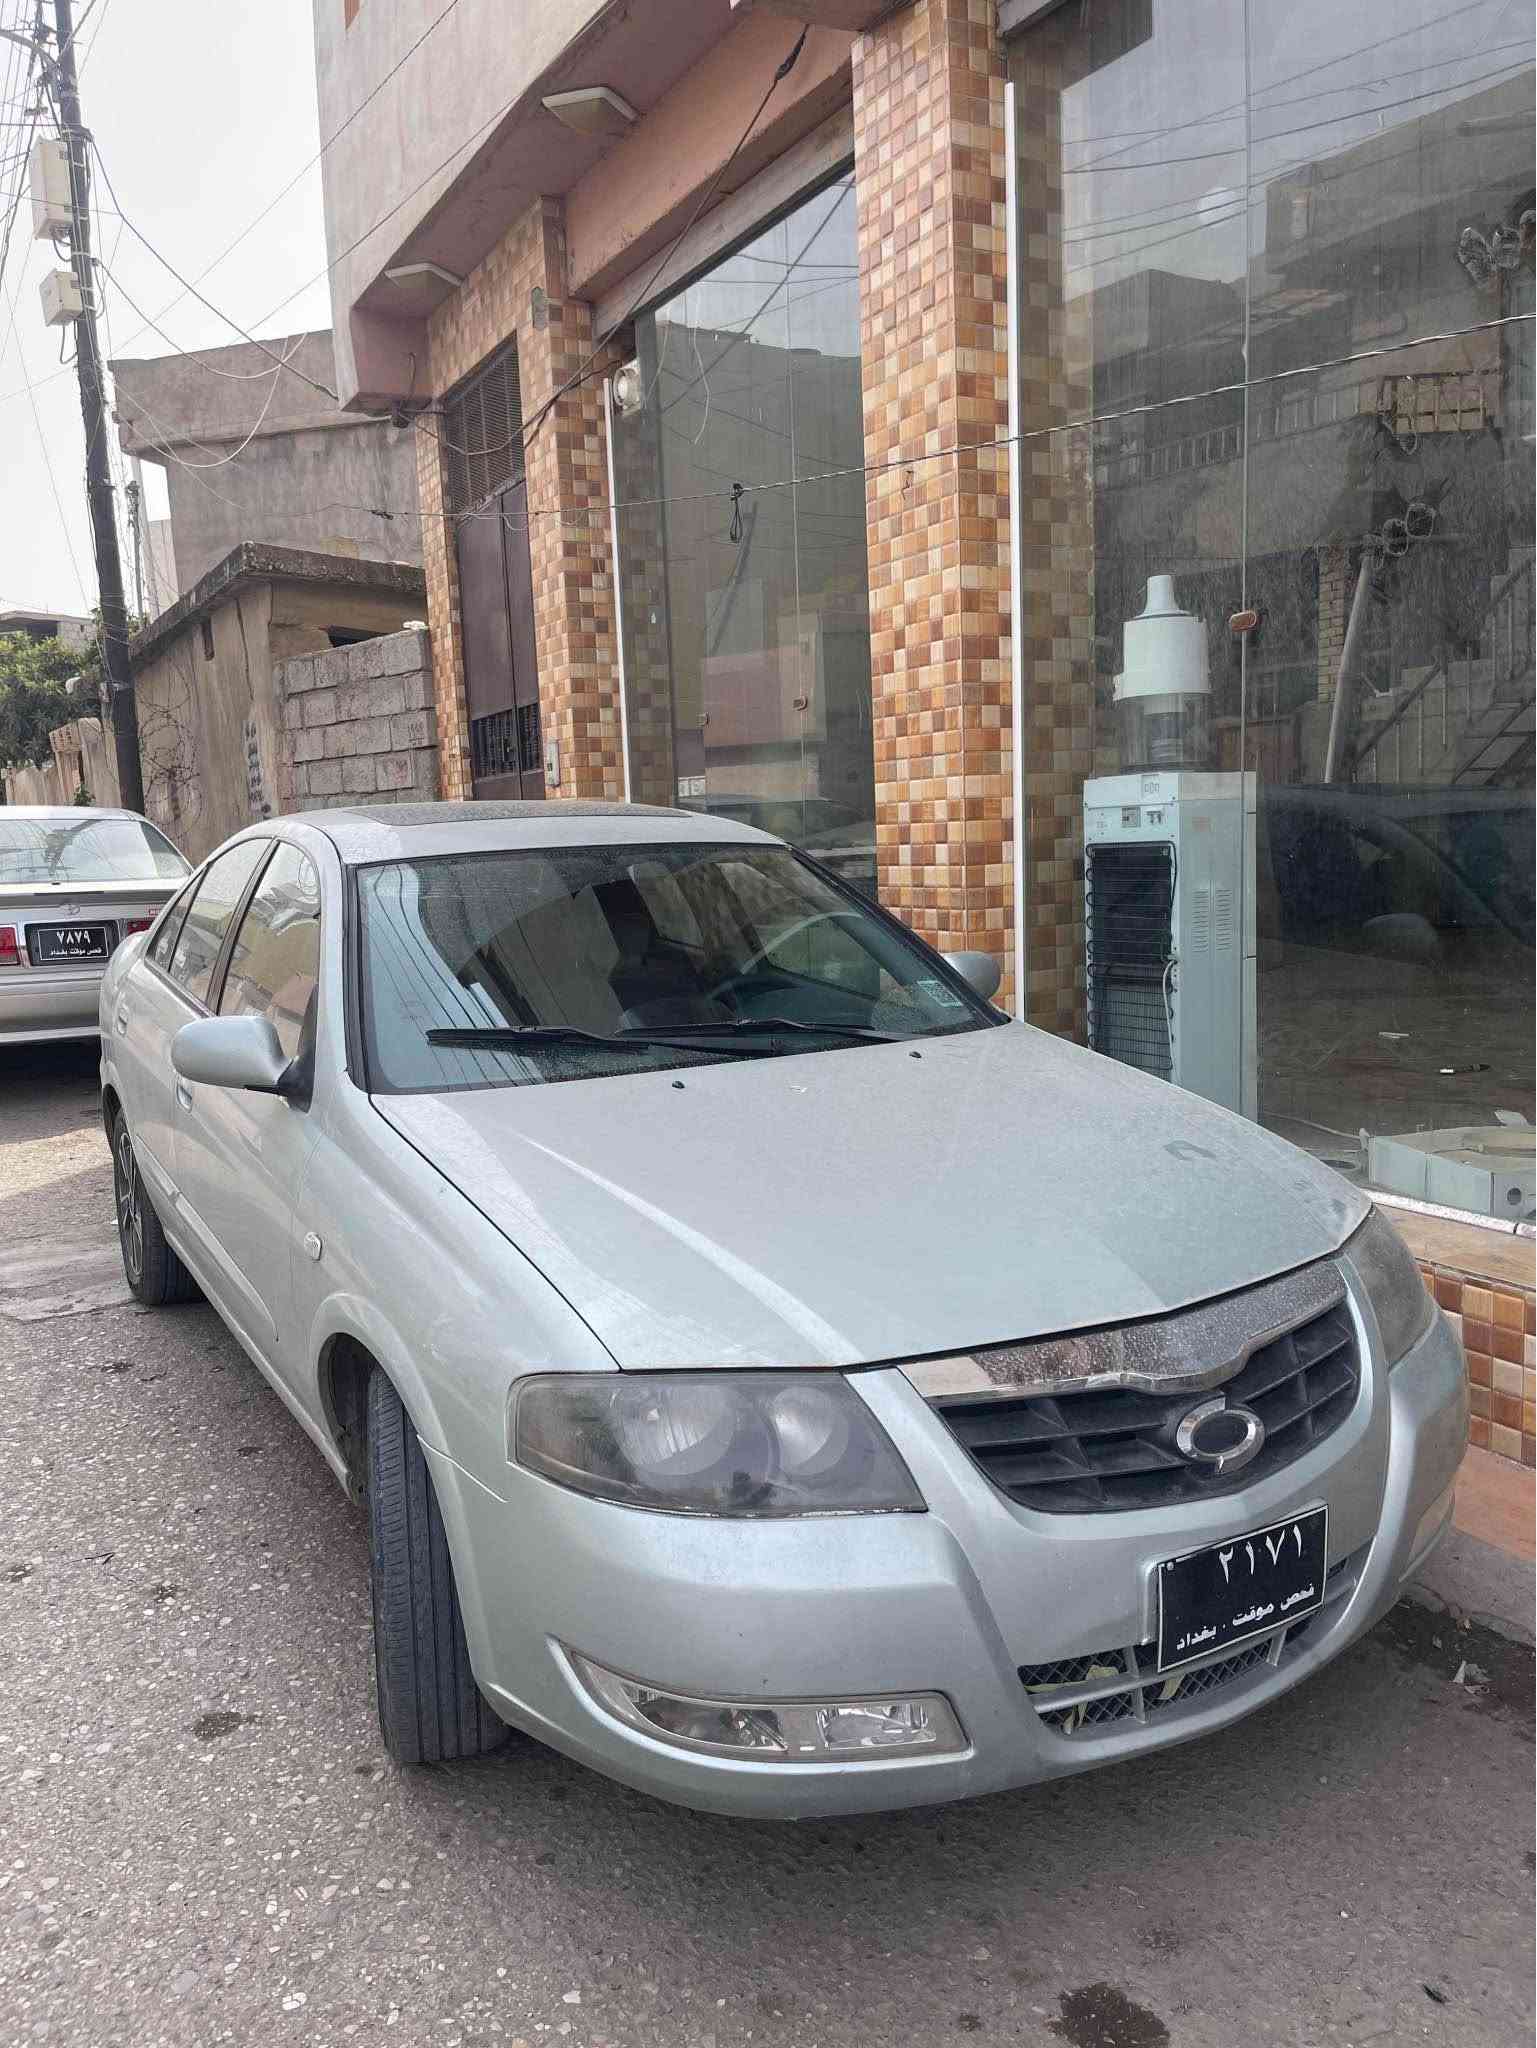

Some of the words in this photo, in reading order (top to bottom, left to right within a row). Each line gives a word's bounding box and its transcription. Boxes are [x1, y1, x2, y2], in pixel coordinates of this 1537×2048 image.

[1219, 1525, 1302, 1584] ٢١٧١
[1281, 1583, 1314, 1611] فحص
[1233, 1604, 1274, 1626] موقت
[1177, 1626, 1217, 1650] بغداد
